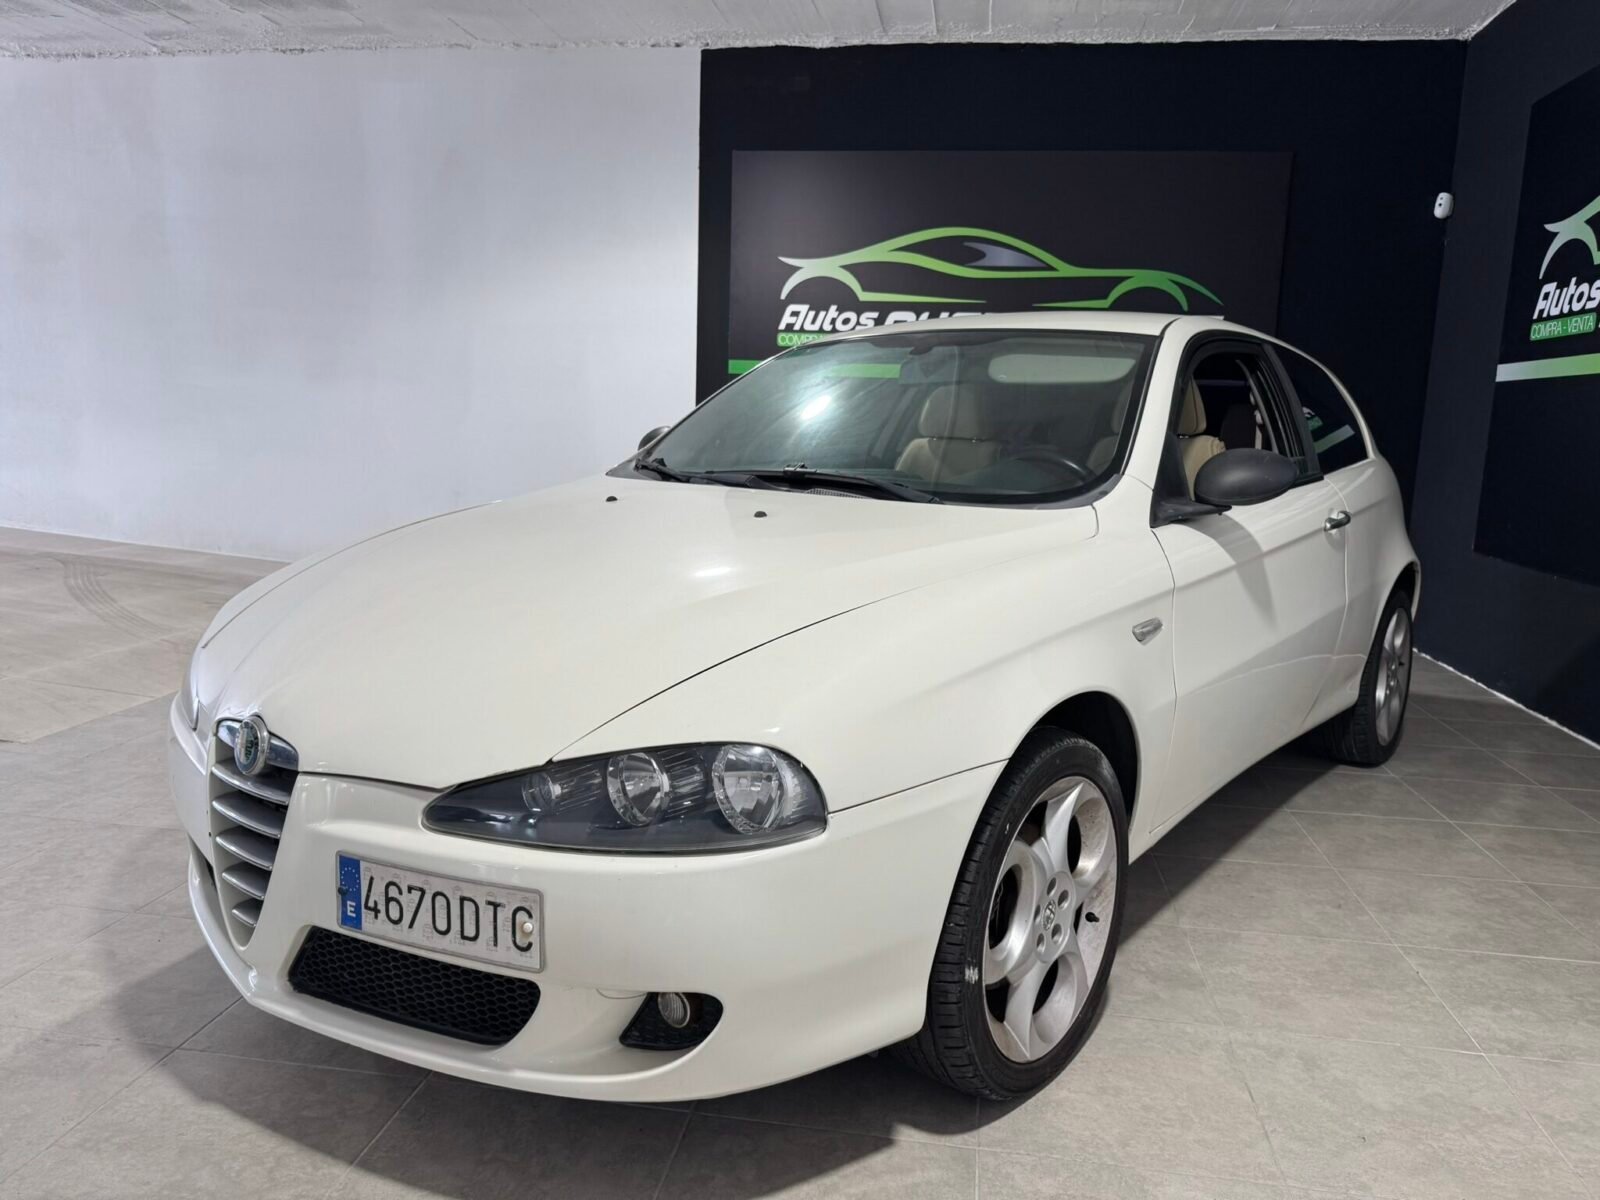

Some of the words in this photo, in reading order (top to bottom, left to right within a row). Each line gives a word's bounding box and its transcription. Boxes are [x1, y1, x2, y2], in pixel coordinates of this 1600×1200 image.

[777, 304, 880, 332] Autos
[1531, 321, 1562, 339] COMPRA
[1567, 314, 1594, 333] VENTA
[347, 901, 356, 917] E
